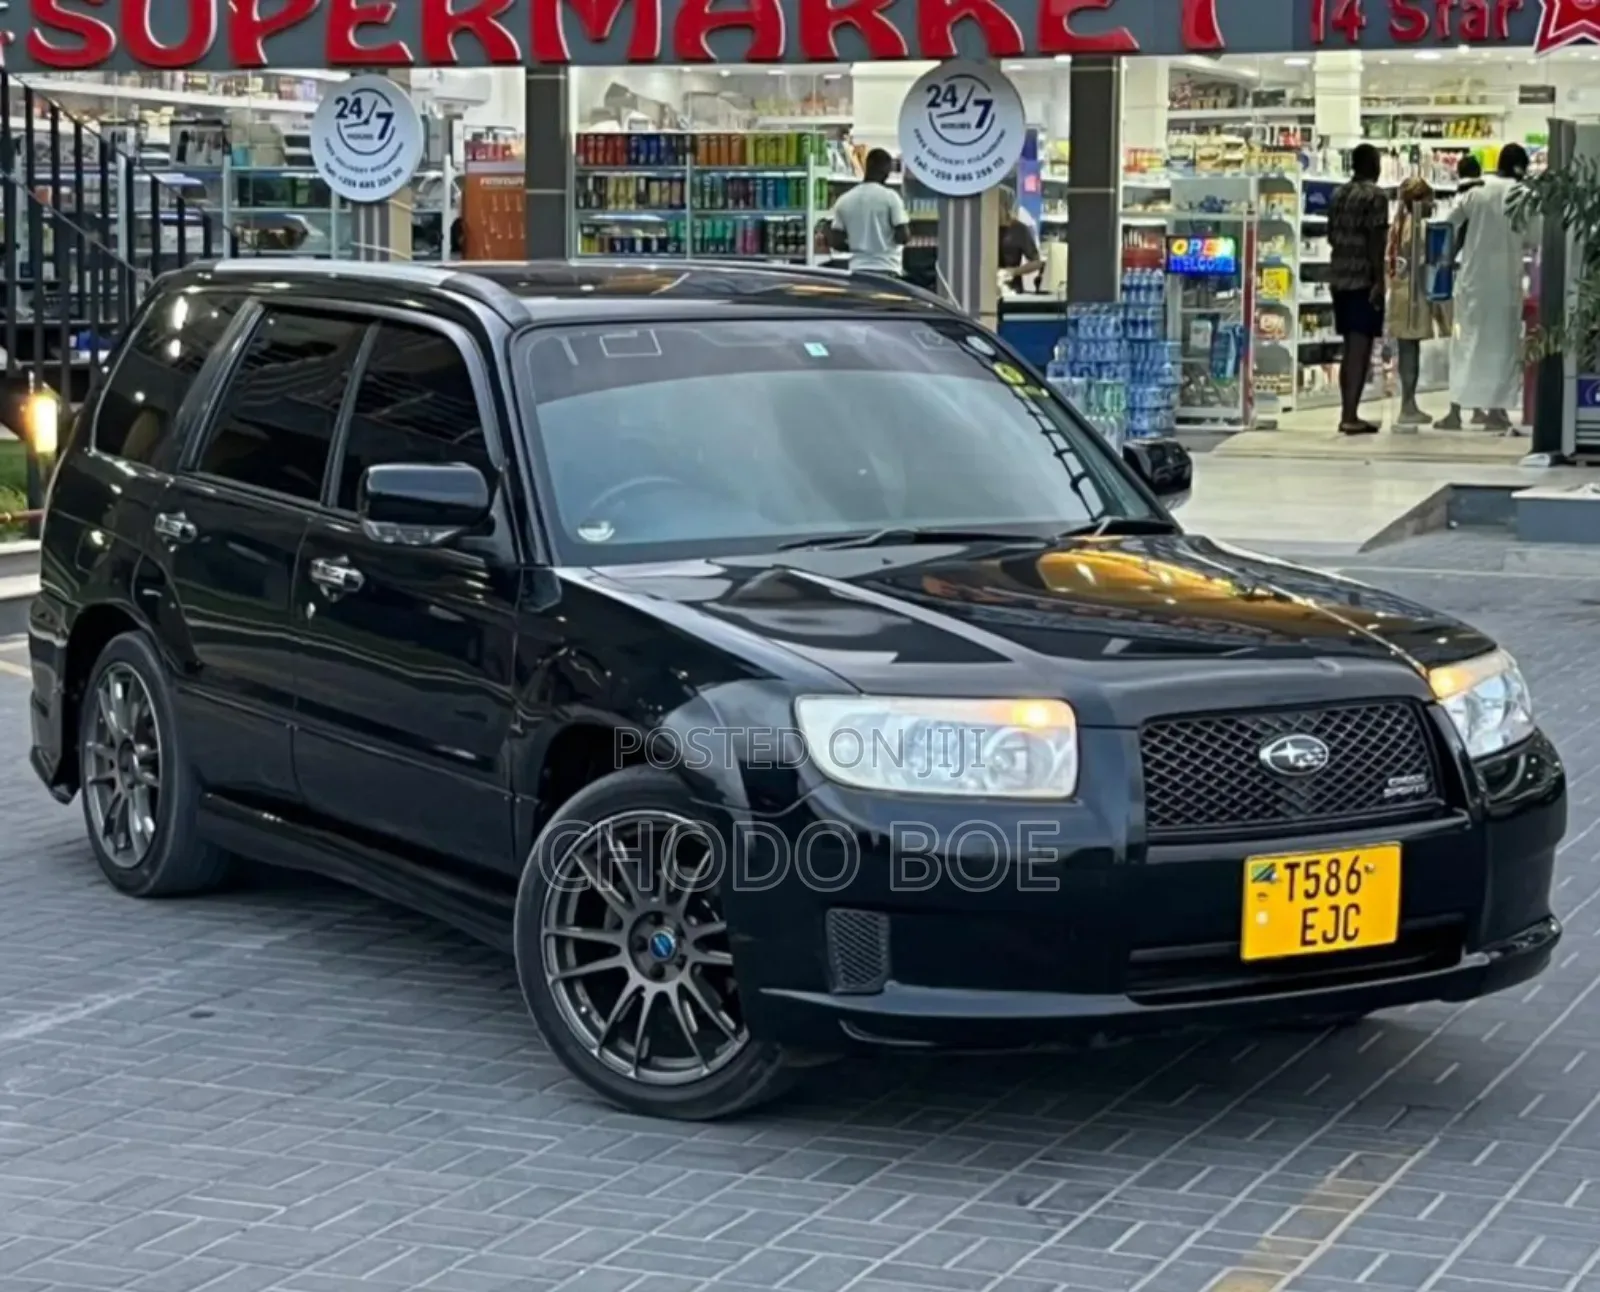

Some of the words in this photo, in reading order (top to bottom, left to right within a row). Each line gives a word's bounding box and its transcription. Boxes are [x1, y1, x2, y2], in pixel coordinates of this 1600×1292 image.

[1309, 0, 1366, 43] 14
[1388, 0, 1523, 41] Star
[1284, 855, 1362, 902] T586
[1300, 903, 1361, 947] EJC
